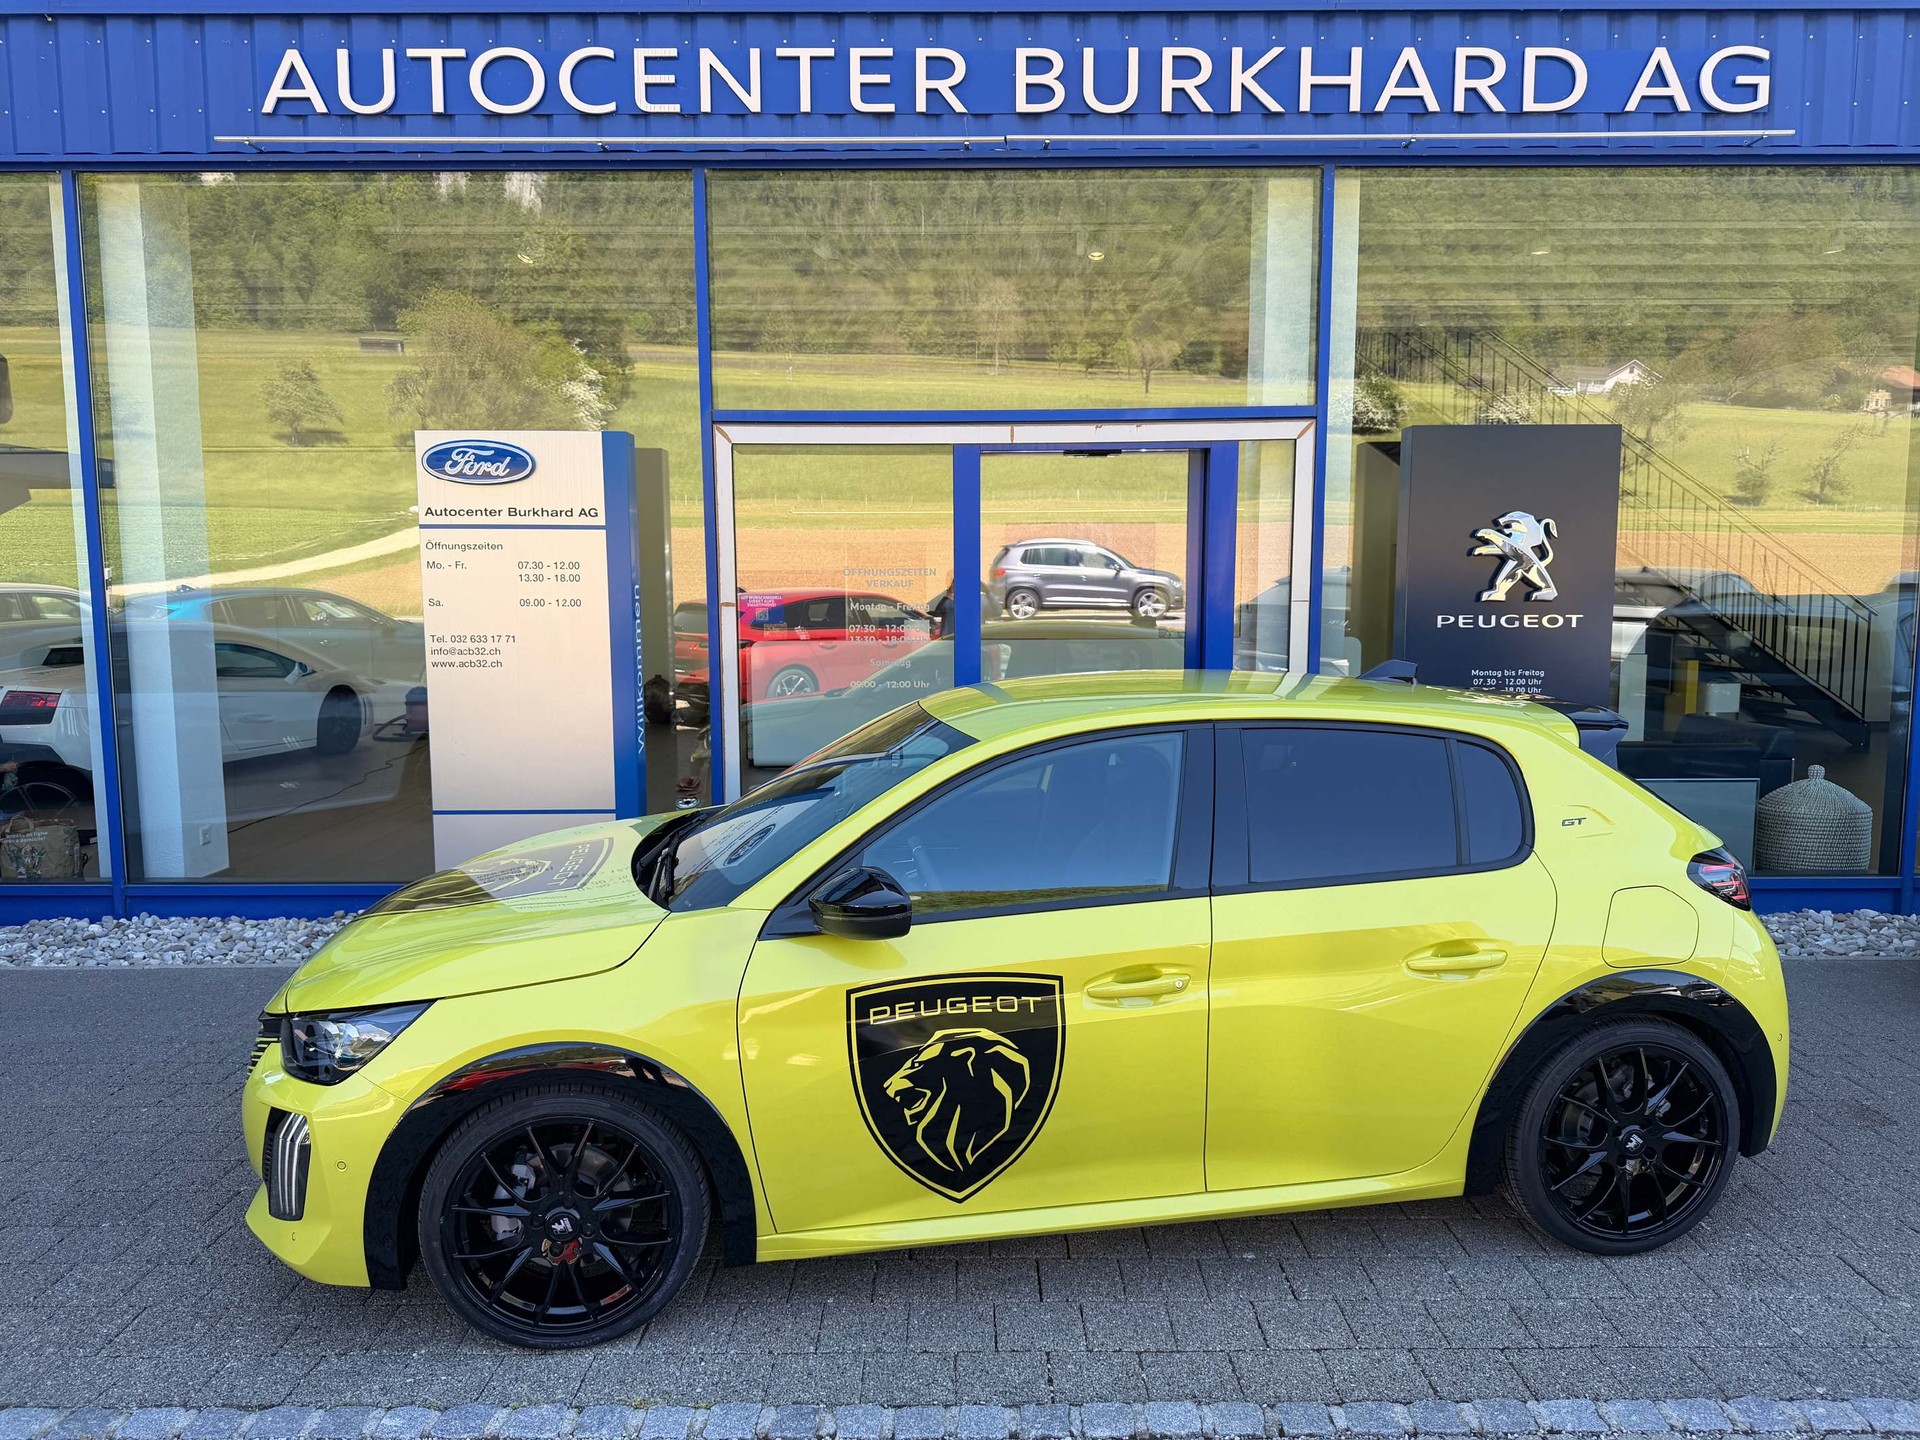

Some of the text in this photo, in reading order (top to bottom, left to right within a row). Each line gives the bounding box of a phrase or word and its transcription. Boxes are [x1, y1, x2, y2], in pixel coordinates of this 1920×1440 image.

[261, 45, 1771, 115] AUTOCENTER BURKHARD AG
[444, 447, 512, 477] Ford
[424, 506, 599, 518] Autocenter Burkhard AG
[425, 539, 504, 552] Öffnungszeiten
[426, 561, 445, 570] Mo.
[454, 561, 468, 570] Fr.
[517, 561, 544, 570] 07.30
[553, 561, 580, 570] 12.00
[518, 574, 544, 583] 13.30
[554, 574, 581, 583] 18.00
[866, 579, 914, 588] VERKAUF
[428, 598, 444, 607] Sa.
[519, 598, 546, 608] 09.00
[555, 598, 582, 608] 12.00
[850, 602, 887, 612] Montag
[1436, 613, 1585, 629] PEUGEOT
[848, 624, 876, 633] 07:30
[430, 635, 516, 643] Tel. 032 633 17 71
[430, 647, 501, 656] info@acb32.ch
[431, 659, 503, 668] www.acb32.ch
[634, 584, 646, 754] Willkommen
[1471, 669, 1502, 678] Montag
[1517, 669, 1545, 678] Freitag
[886, 680, 912, 689] 12:00
[913, 680, 931, 689] Uhr
[1472, 678, 1497, 686] 07.30
[1505, 678, 1526, 686] 12.00
[1528, 678, 1542, 686] Uhr
[1528, 686, 1542, 694] Uhr
[1561, 817, 1587, 827] GT
[869, 994, 1042, 1026] PEUGEOT
